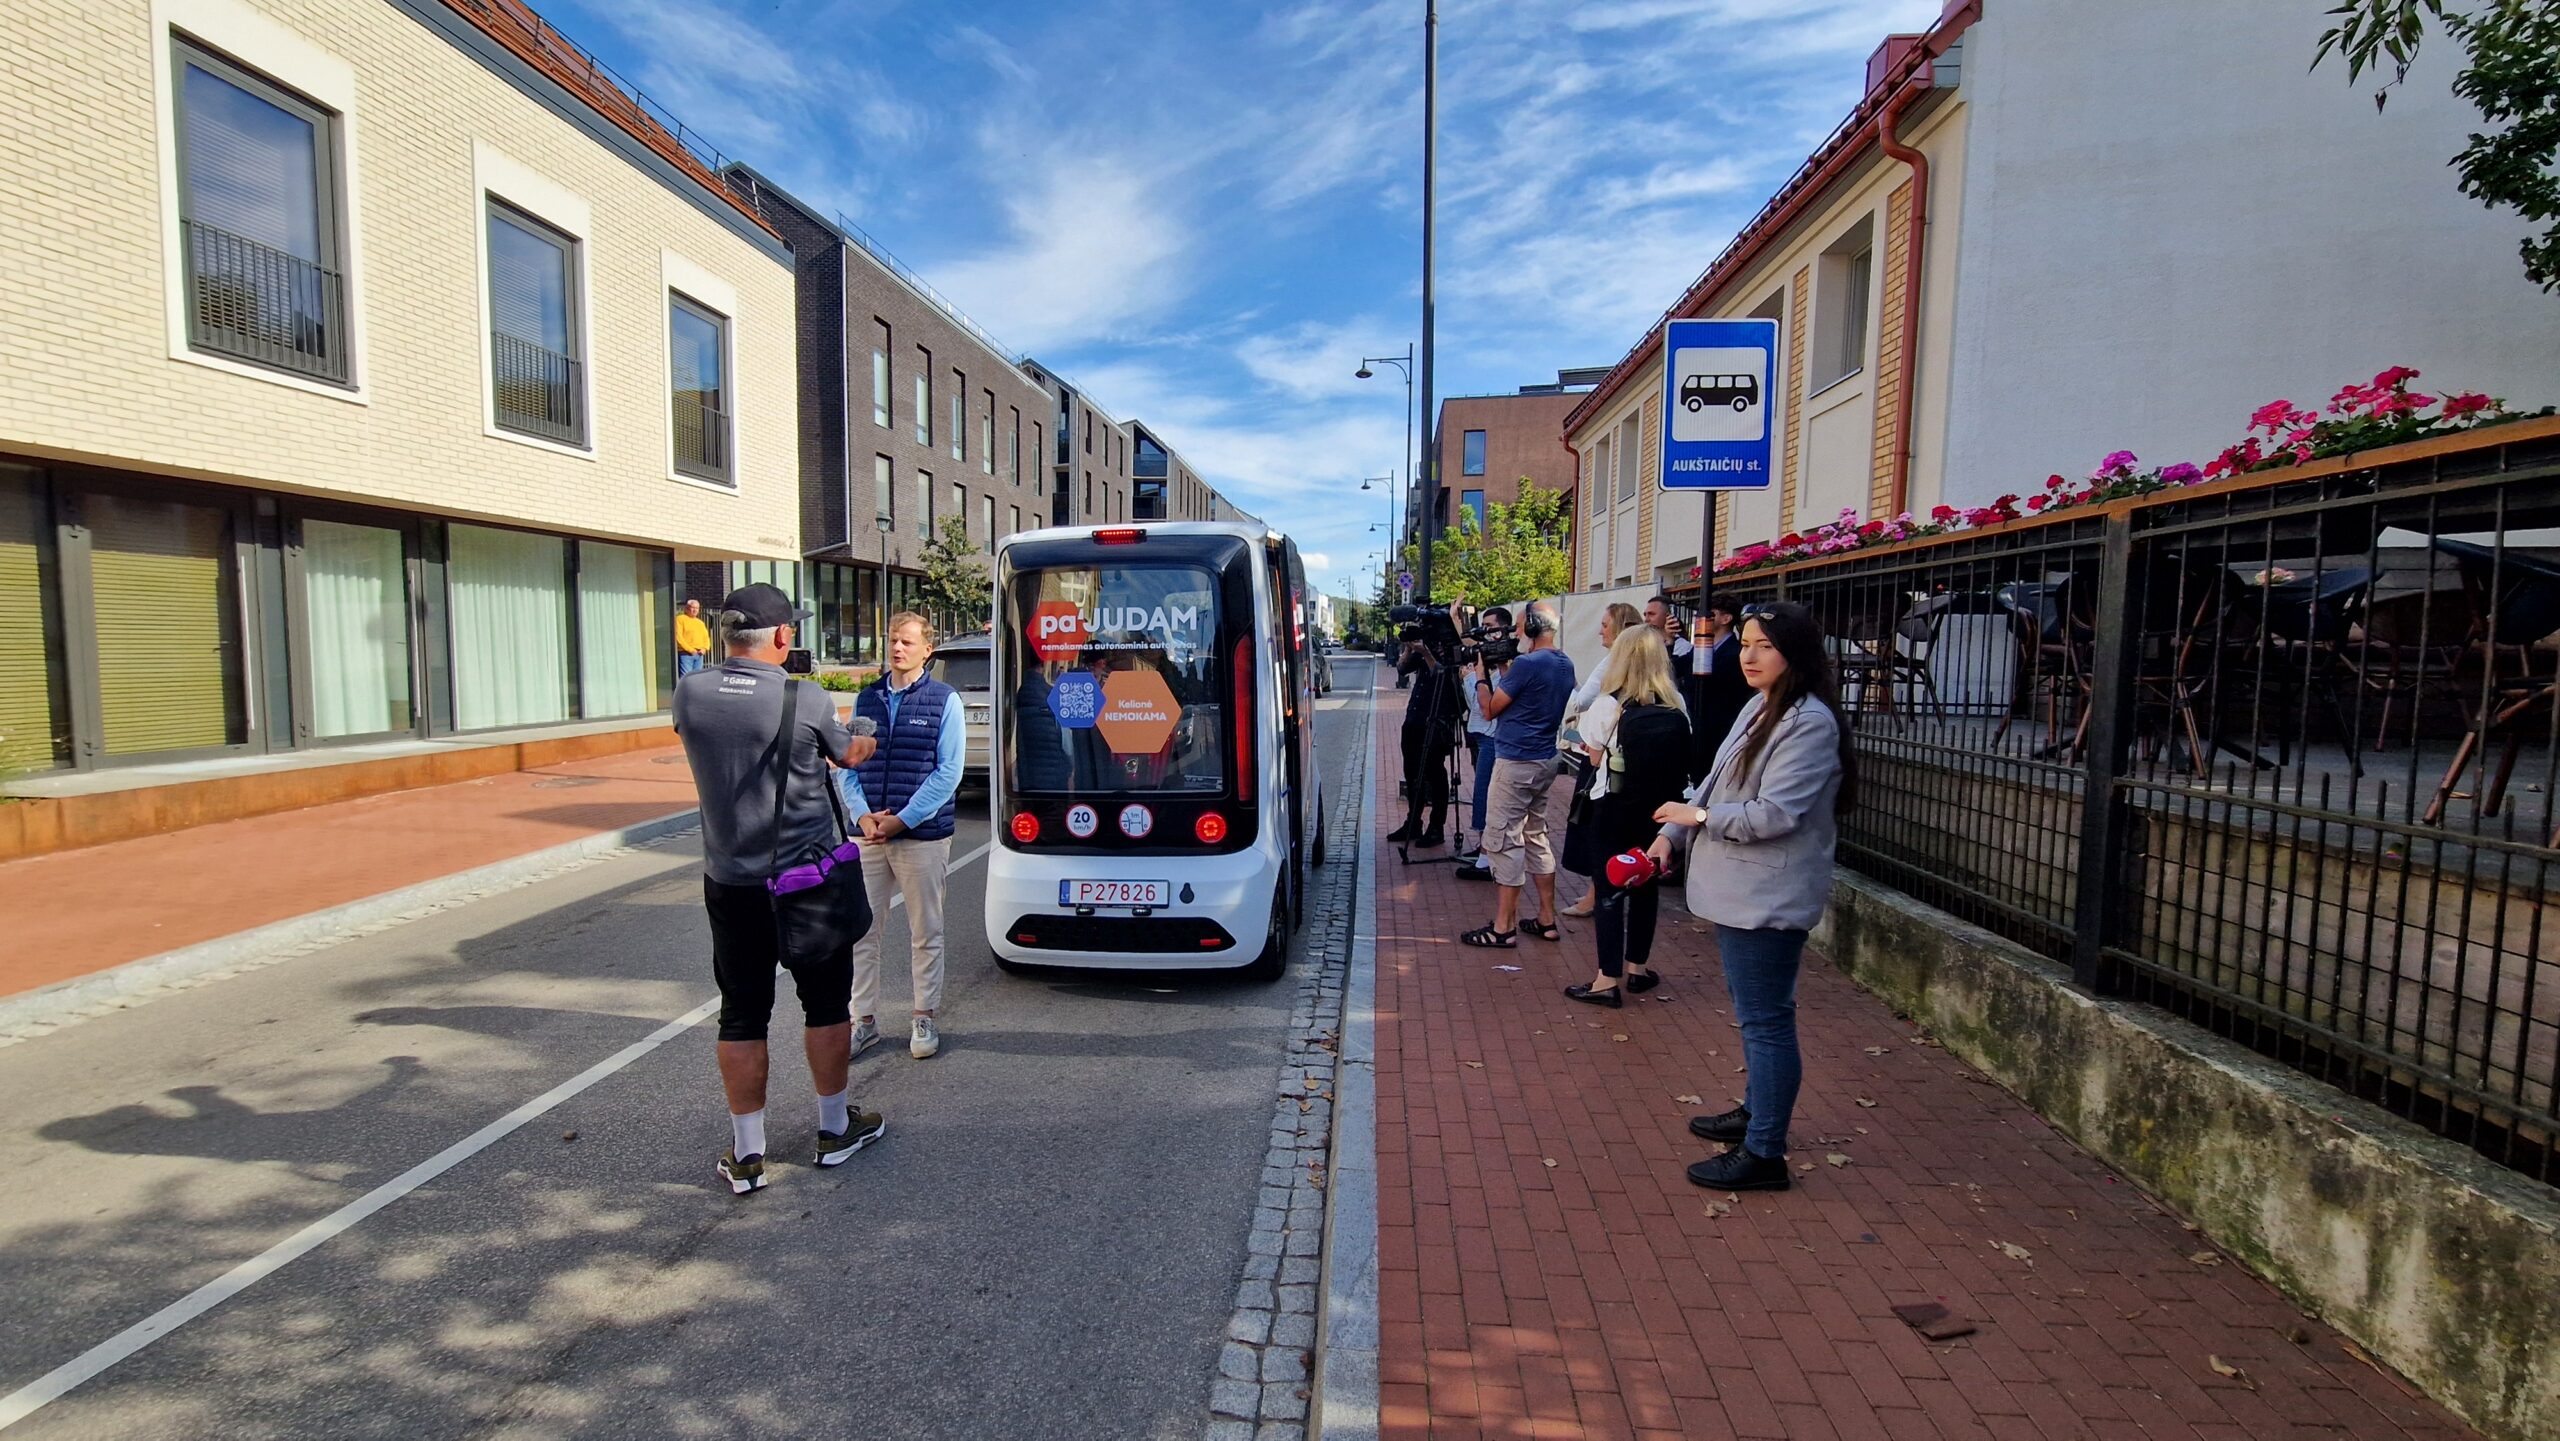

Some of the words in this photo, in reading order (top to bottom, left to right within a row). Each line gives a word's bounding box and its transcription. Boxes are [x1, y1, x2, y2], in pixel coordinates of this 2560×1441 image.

[1672, 456, 1743, 474] AUKŠTAIČIŲ
[1746, 459, 1762, 471] st.
[788, 535, 795, 549] 2
[1041, 642, 1093, 651] nemokamas
[1094, 641, 1148, 651] autonominis
[973, 712, 991, 722] 873
[1105, 711, 1167, 721] NEMOKAMA
[1073, 811, 1091, 823] 20
[1080, 883, 1156, 902] P27826
